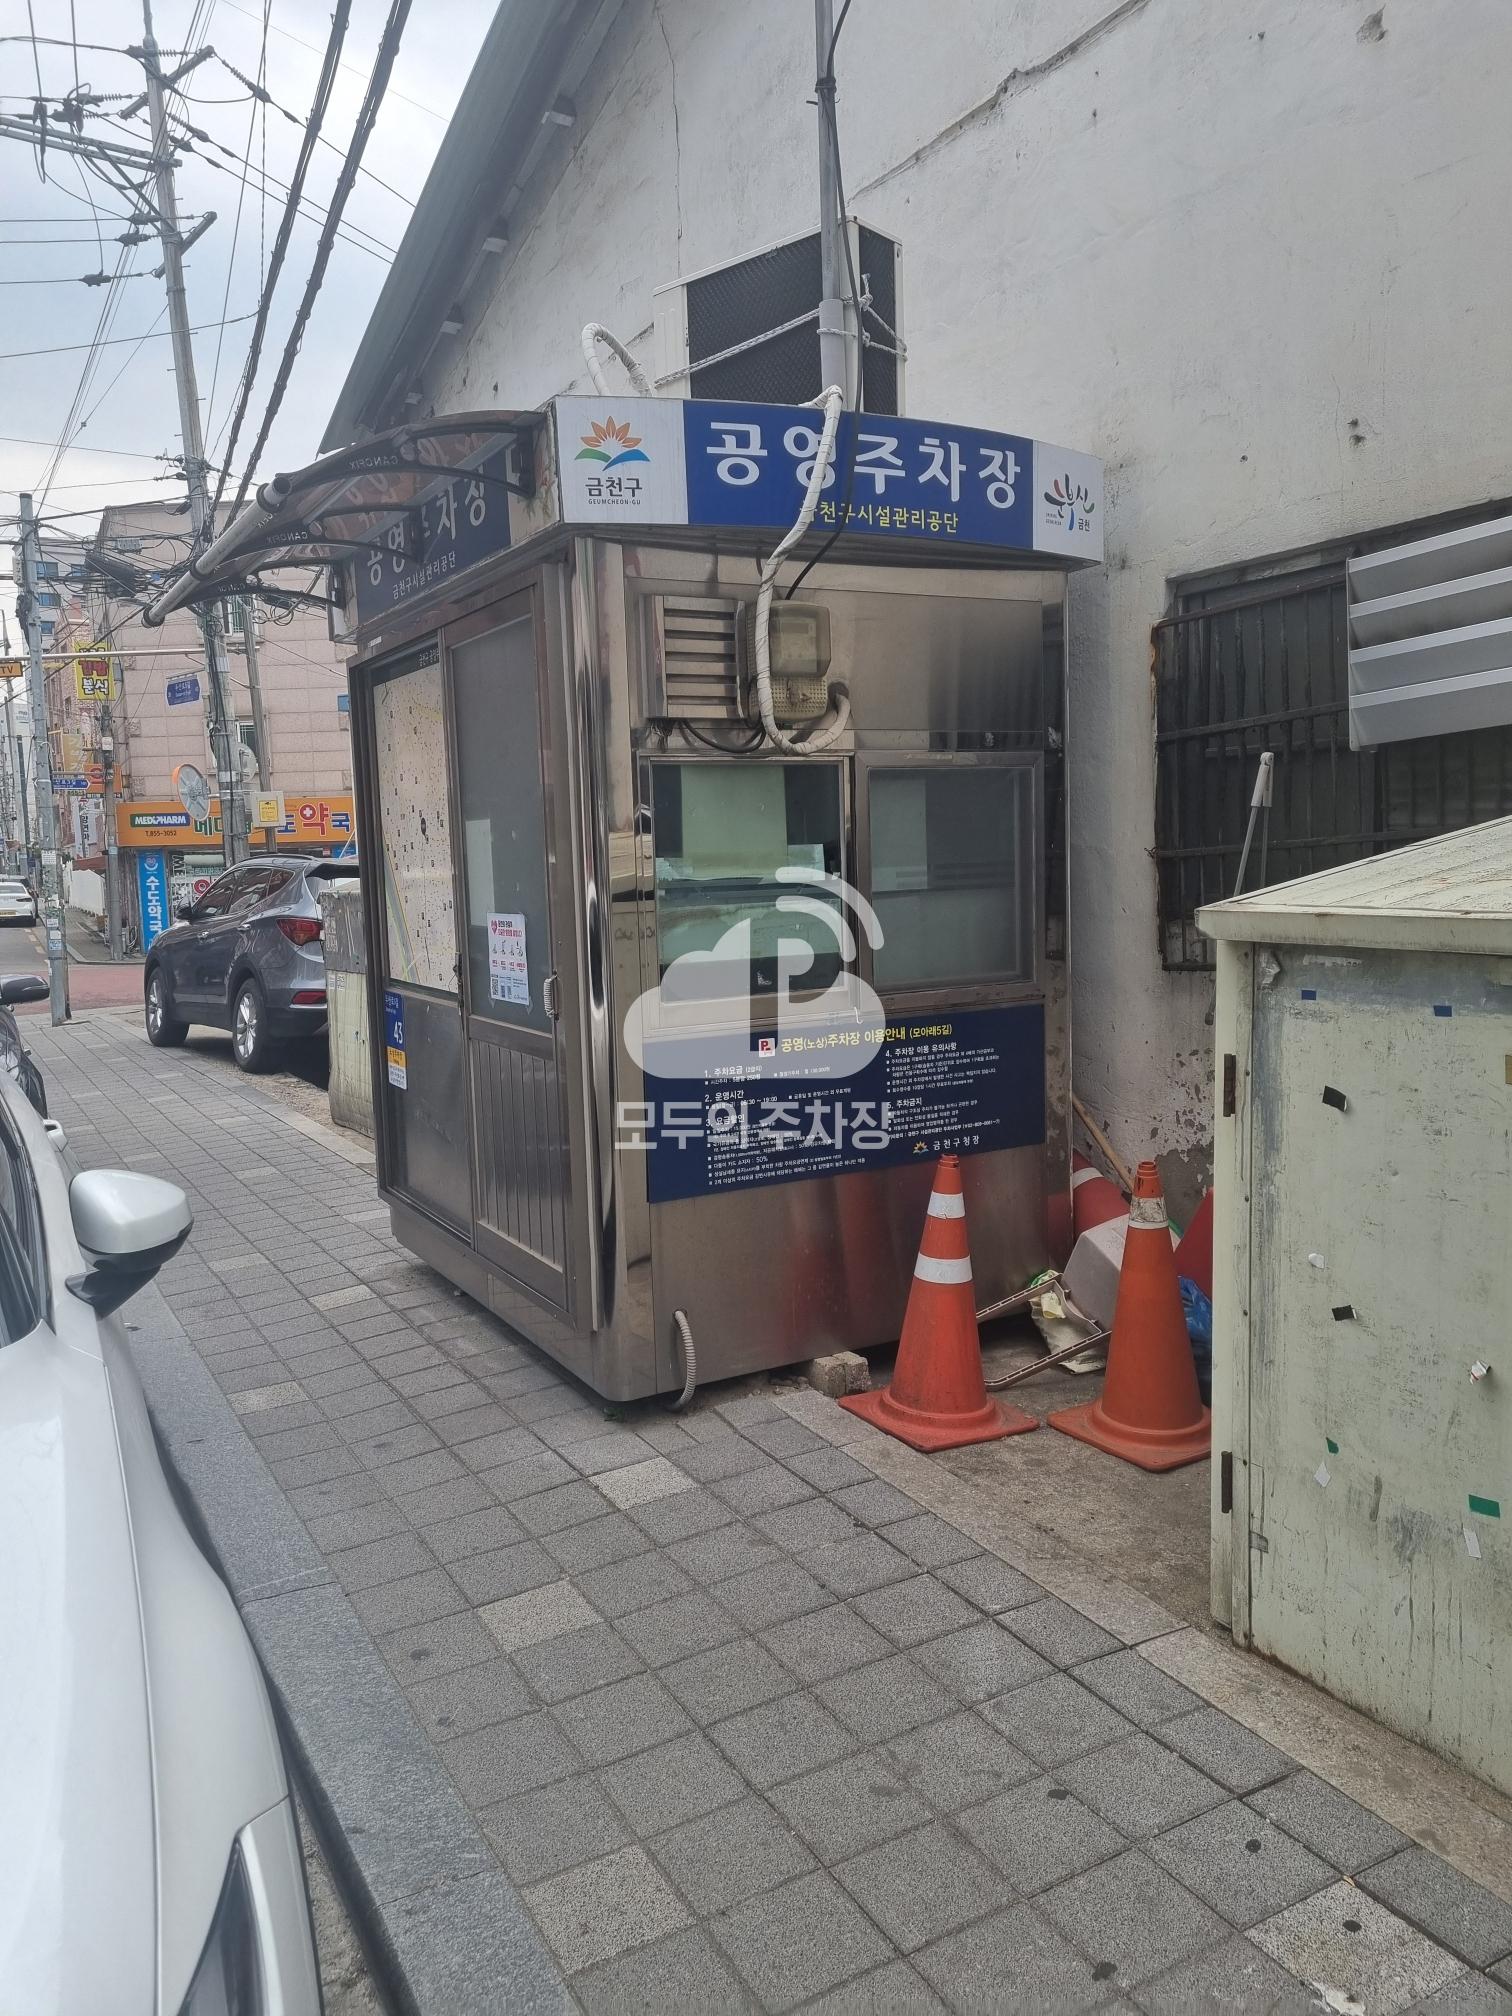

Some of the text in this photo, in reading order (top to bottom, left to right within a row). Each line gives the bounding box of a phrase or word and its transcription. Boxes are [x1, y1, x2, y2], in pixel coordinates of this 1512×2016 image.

[706, 421, 1021, 509] 공영주차장
[585, 477, 643, 497] 금천구
[82, 676, 109, 695] 분식
[393, 1020, 404, 1045] 43
[780, 1031, 860, 1052] 공영(노상)주차장
[864, 1026, 905, 1043] 이용안내
[894, 1046, 914, 1056] 주차장
[916, 1044, 929, 1054] 이용
[931, 1042, 957, 1053] 유의사항
[713, 1065, 743, 1077] 주차요금
[714, 1089, 744, 1101] 운영시간
[896, 1097, 922, 1108] 주차금지
[755, 1155, 768, 1163] 50%
